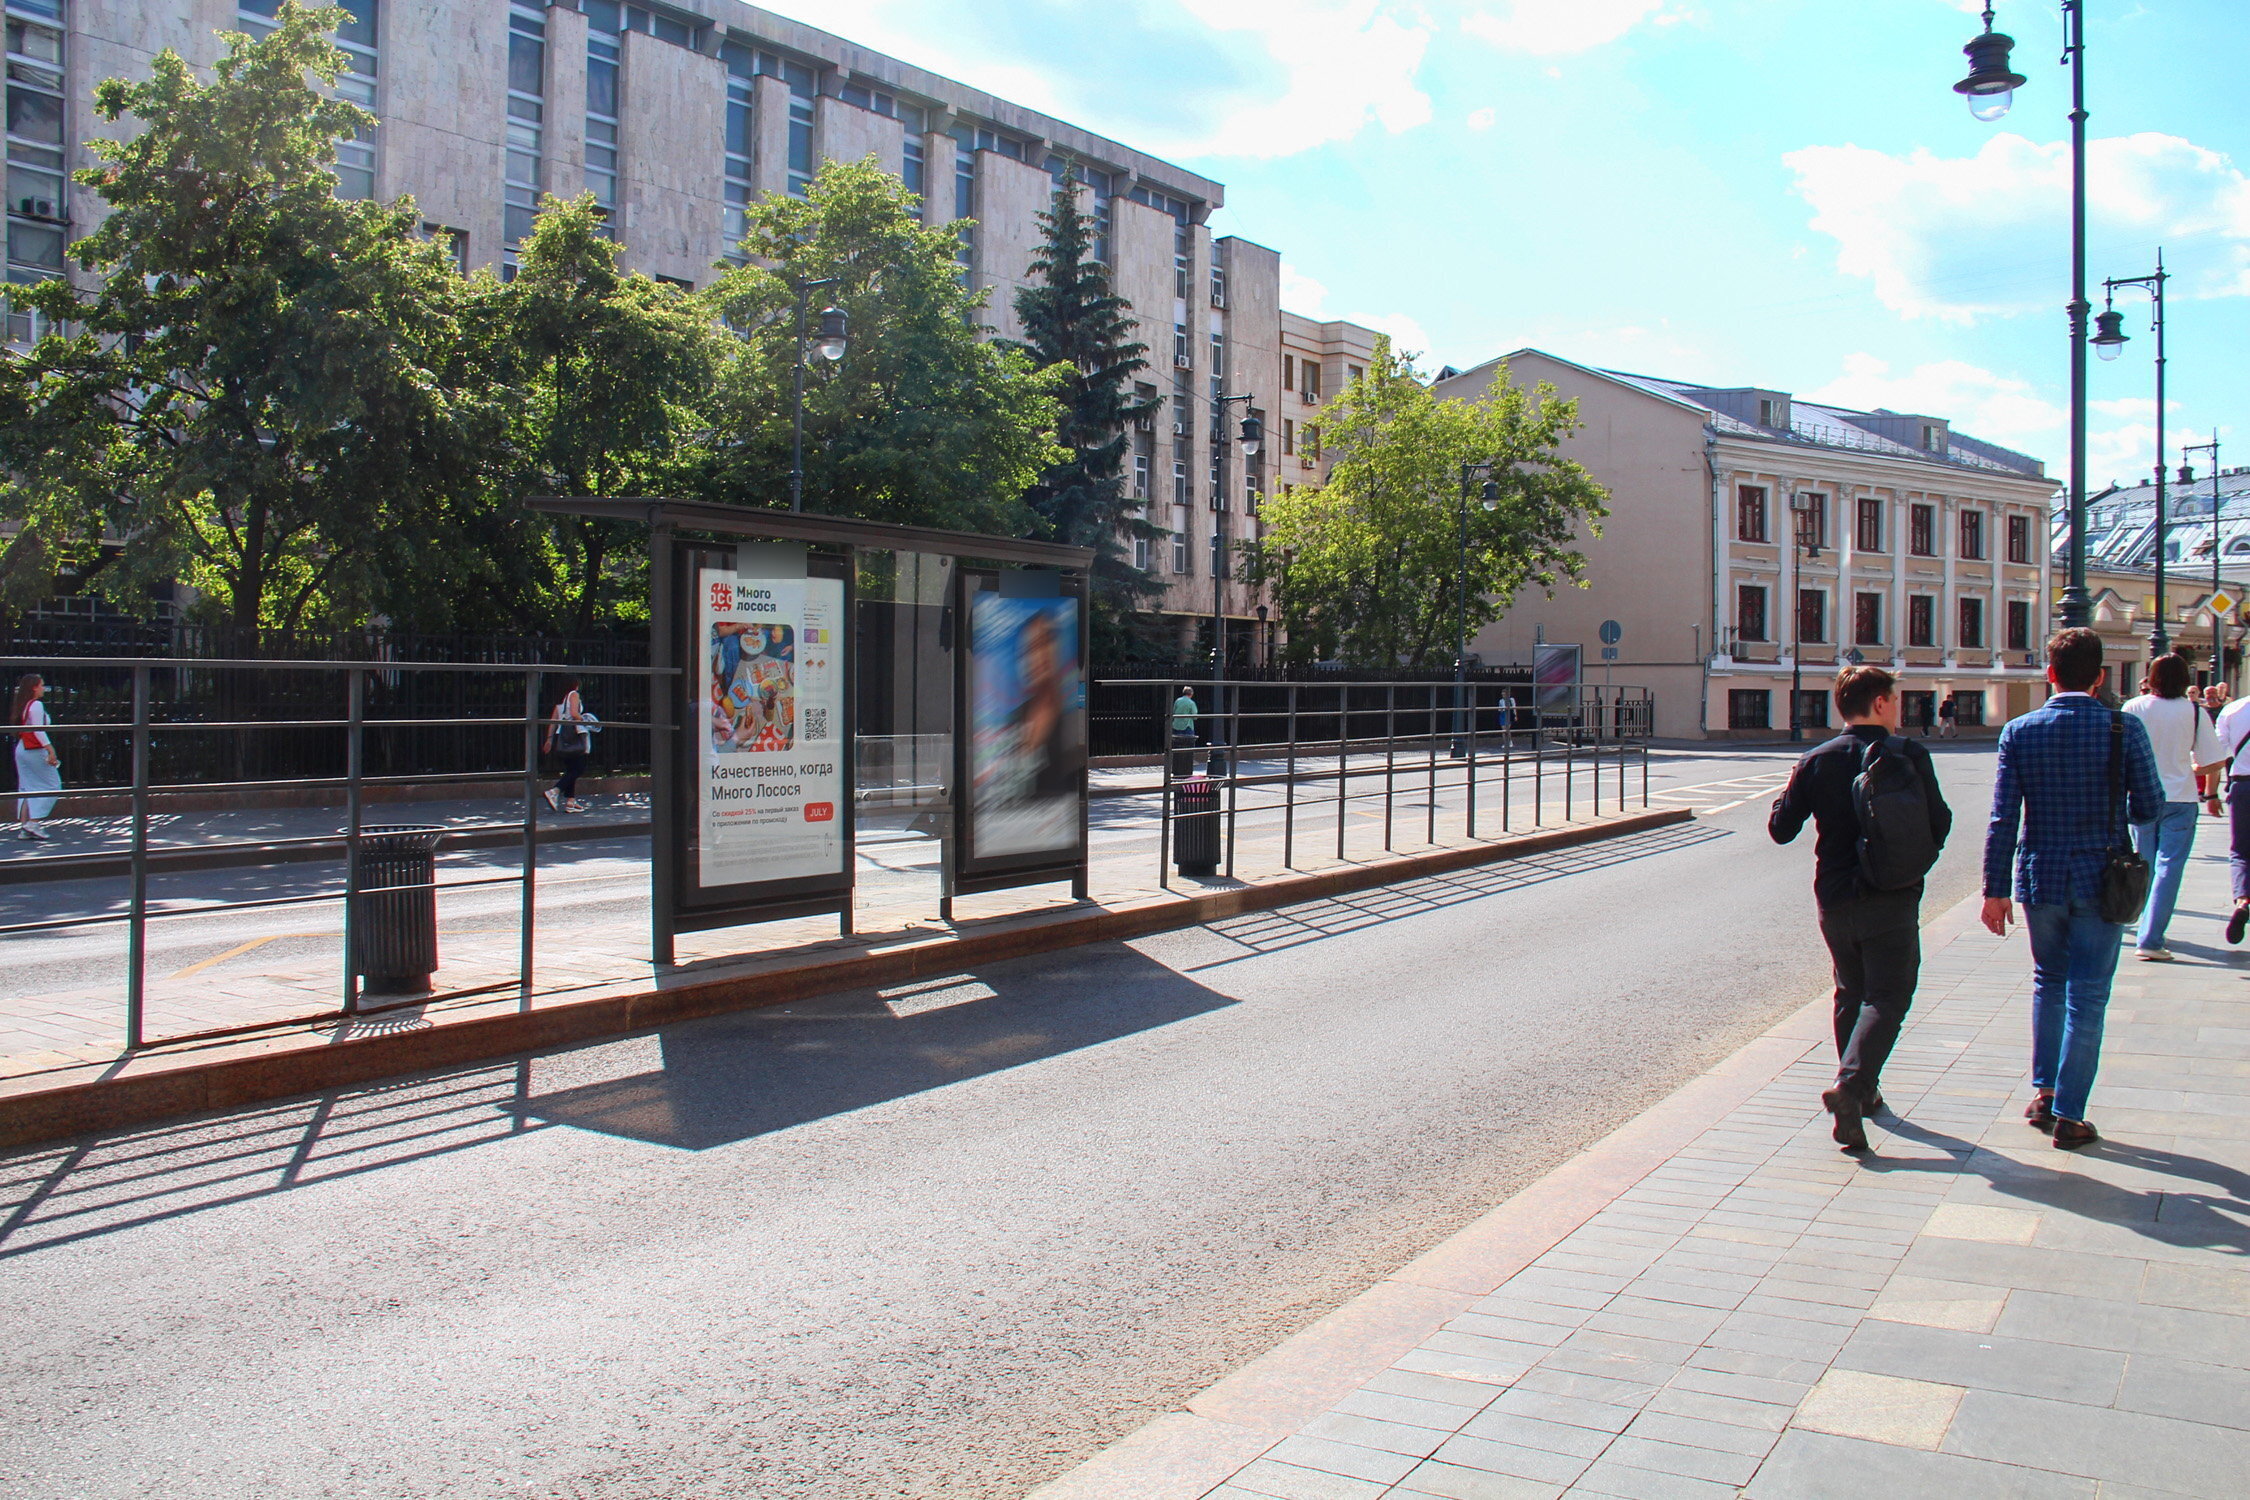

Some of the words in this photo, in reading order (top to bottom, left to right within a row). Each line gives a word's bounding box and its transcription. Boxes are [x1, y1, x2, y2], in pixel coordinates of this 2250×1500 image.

[736, 586, 771, 599] Много
[736, 602, 777, 612] лосося
[711, 764, 797, 779] Качественно,
[800, 763, 833, 776] когда
[711, 786, 753, 800] Много
[756, 784, 801, 797] Лосося
[721, 809, 744, 817] скидкой
[809, 808, 828, 817] JULY
[760, 817, 788, 825] промокоду
